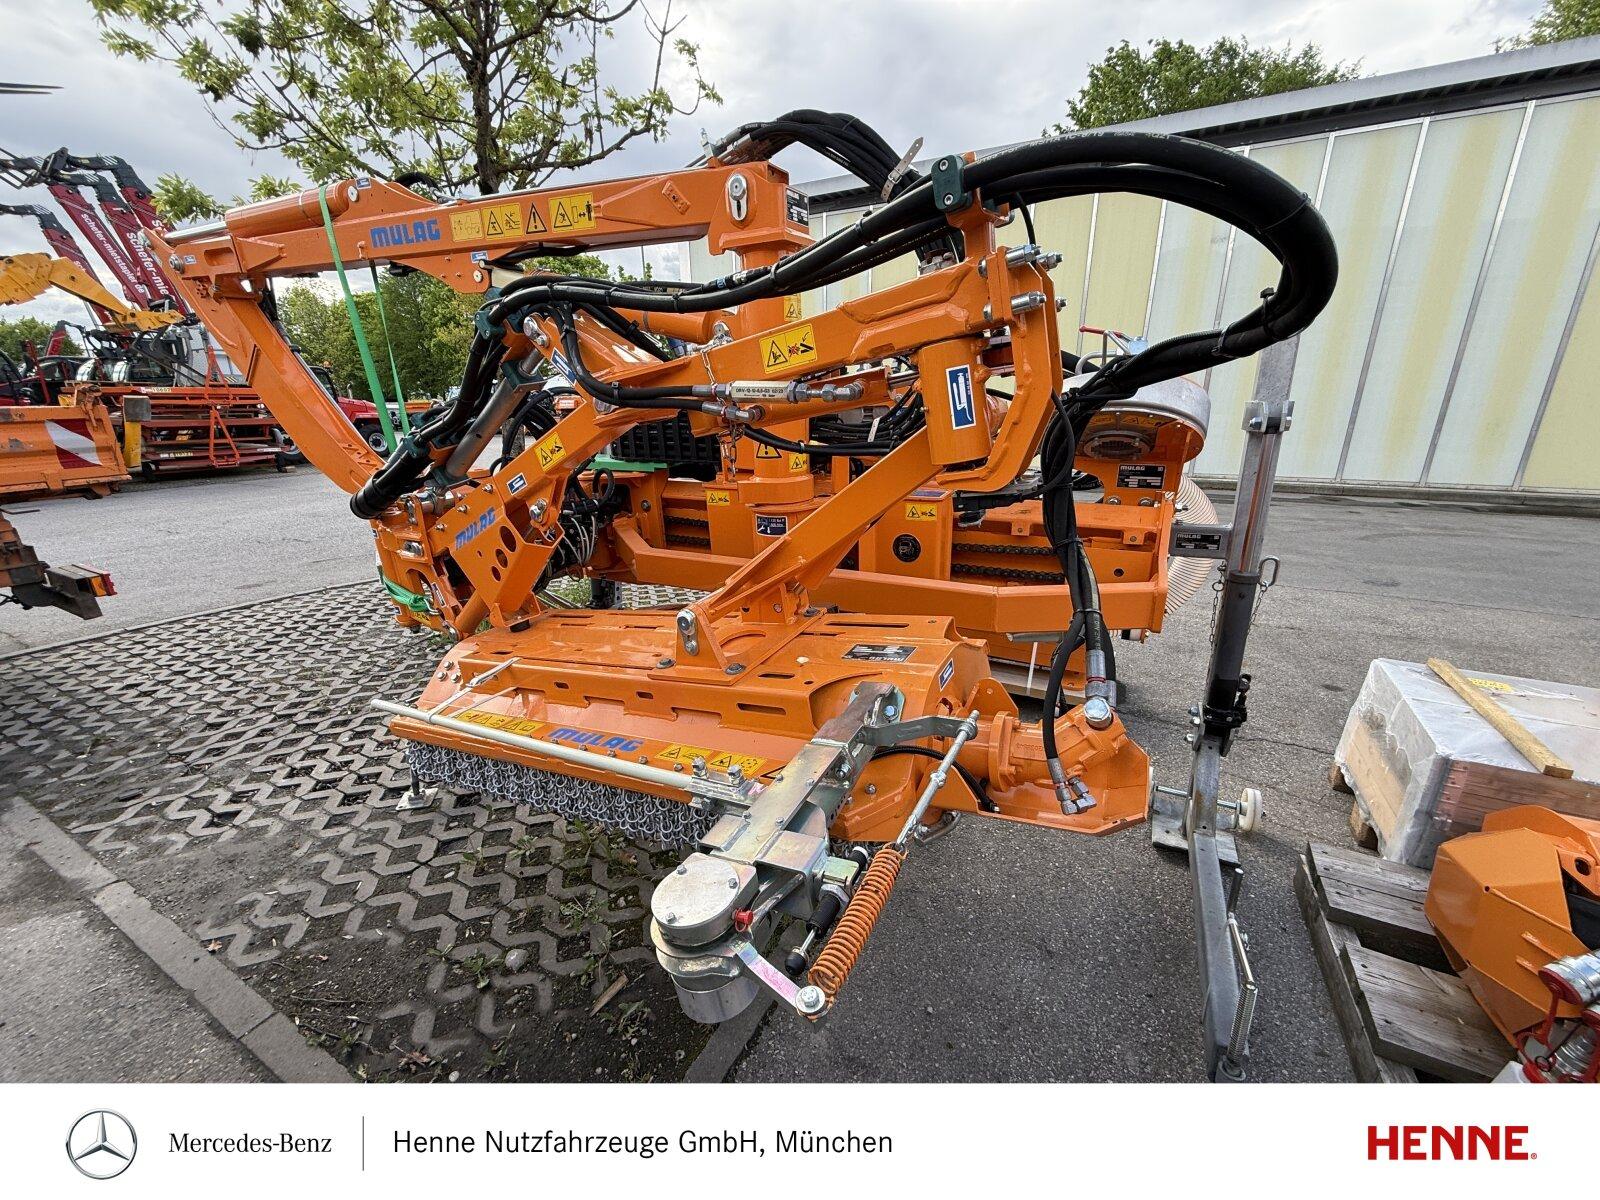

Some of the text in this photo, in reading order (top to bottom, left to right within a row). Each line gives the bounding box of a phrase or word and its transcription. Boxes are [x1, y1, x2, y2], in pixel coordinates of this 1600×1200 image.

[370, 218, 441, 249] MULAG
[455, 506, 496, 551] MULAG
[548, 728, 644, 752] MULAG
